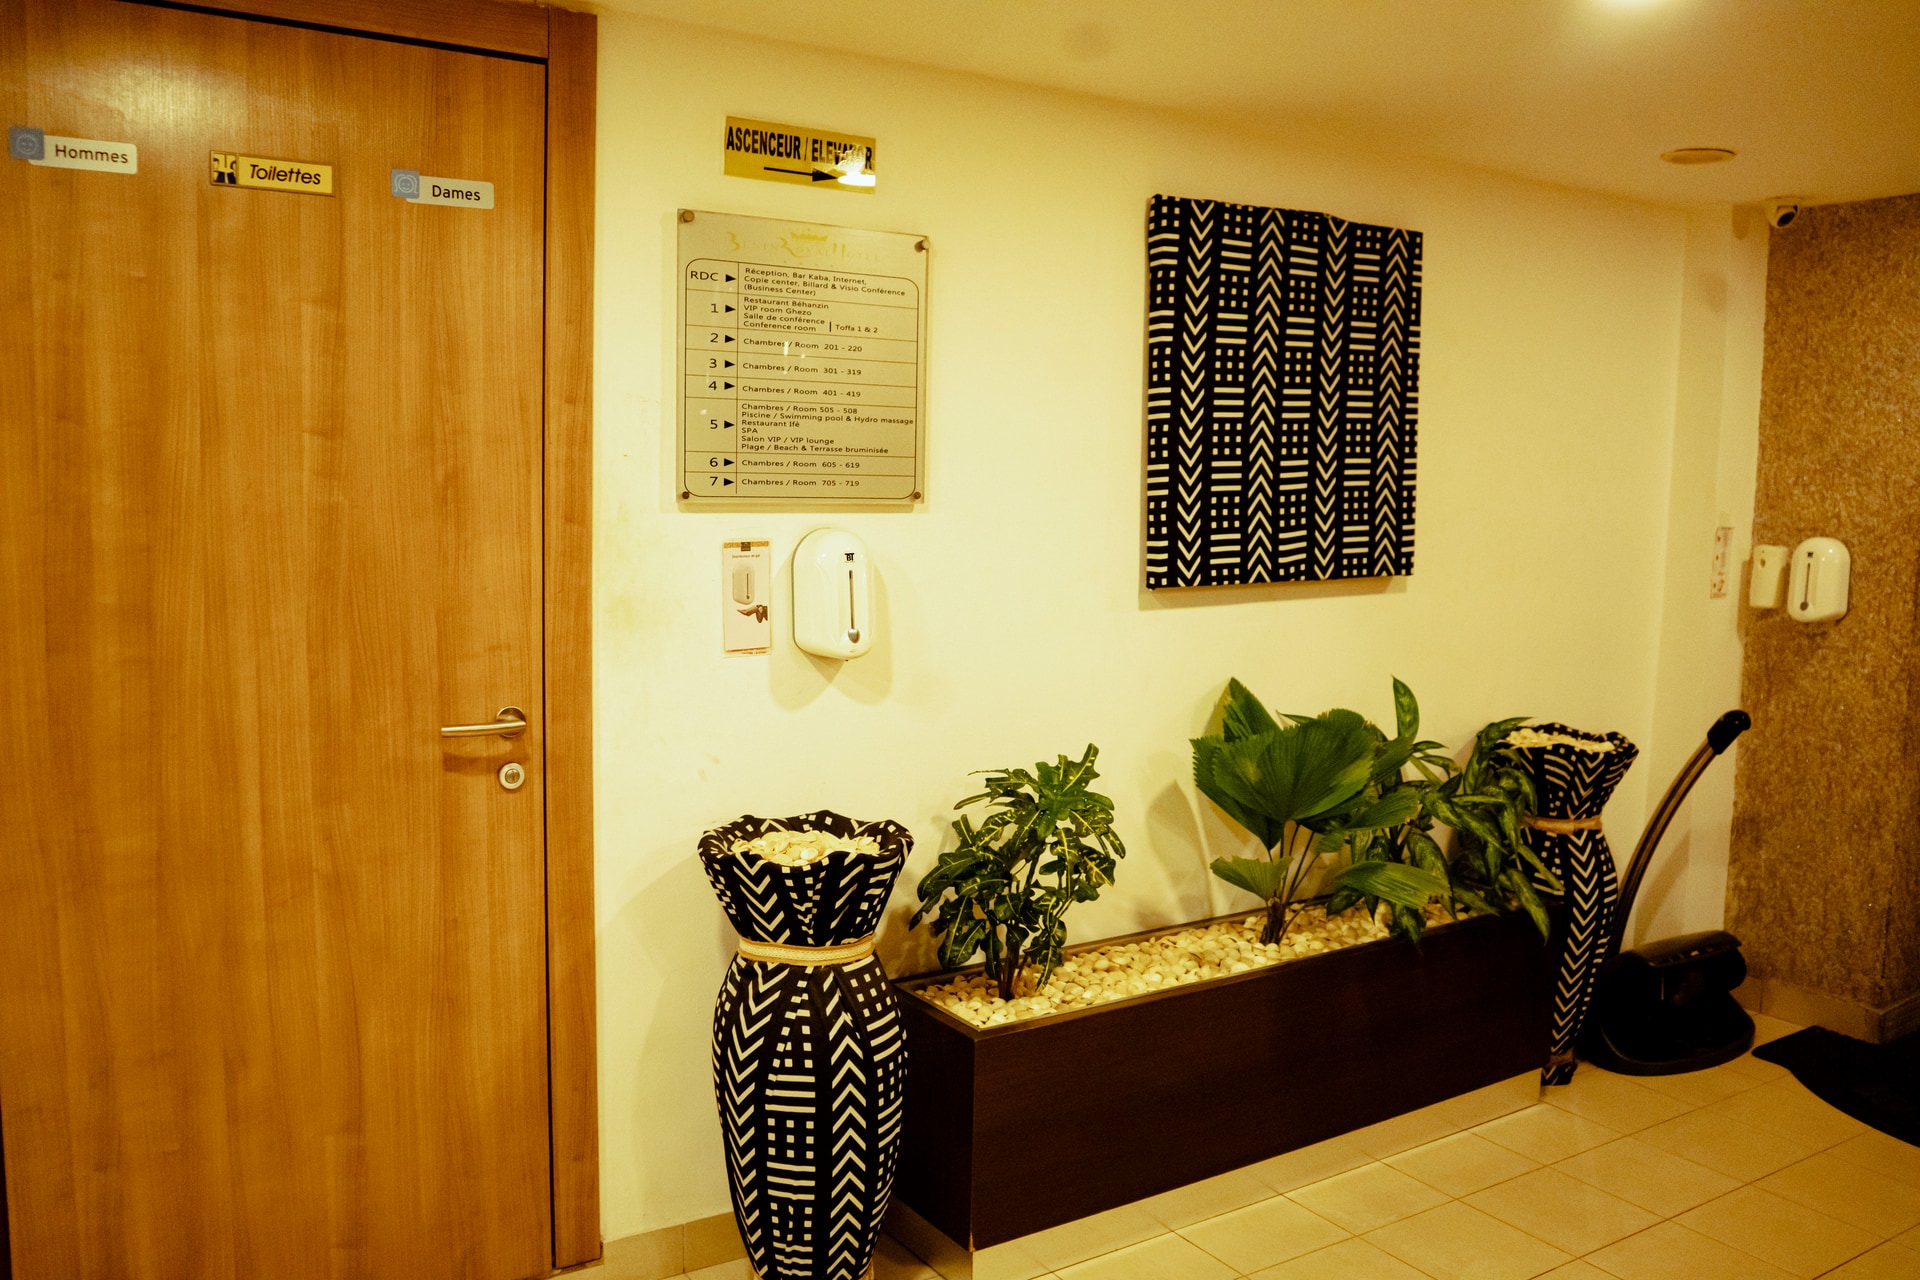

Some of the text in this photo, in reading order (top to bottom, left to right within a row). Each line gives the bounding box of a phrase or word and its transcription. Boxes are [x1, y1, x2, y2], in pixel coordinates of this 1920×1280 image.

[726, 126, 801, 161] ASCENCEUR
[804, 137, 808, 161] /
[55, 143, 129, 164] Hommes
[249, 163, 321, 186] Toilettes
[432, 185, 481, 201] Dames
[690, 270, 719, 281] RDC
[744, 276, 769, 286] Copie
[802, 280, 828, 289] Billard
[840, 283, 859, 292] Visio
[786, 287, 816, 297] Center)
[744, 297, 789, 306] Restaurant
[711, 304, 718, 313] 1
[786, 308, 812, 316] Ghezo
[744, 321, 792, 331] Conference
[710, 333, 718, 343] 2
[743, 338, 785, 348] Chambres
[709, 359, 717, 368] 3
[742, 363, 785, 372] Chambres
[709, 381, 717, 391] 4
[742, 386, 784, 394] Chambres
[742, 403, 784, 411] Chambres
[780, 413, 822, 422] Swimming
[854, 416, 878, 424] Hydro
[710, 420, 718, 429] 5
[742, 420, 787, 428] Restaurant
[742, 444, 764, 452] Plage
[710, 458, 718, 467] 6
[710, 477, 718, 486] 7
